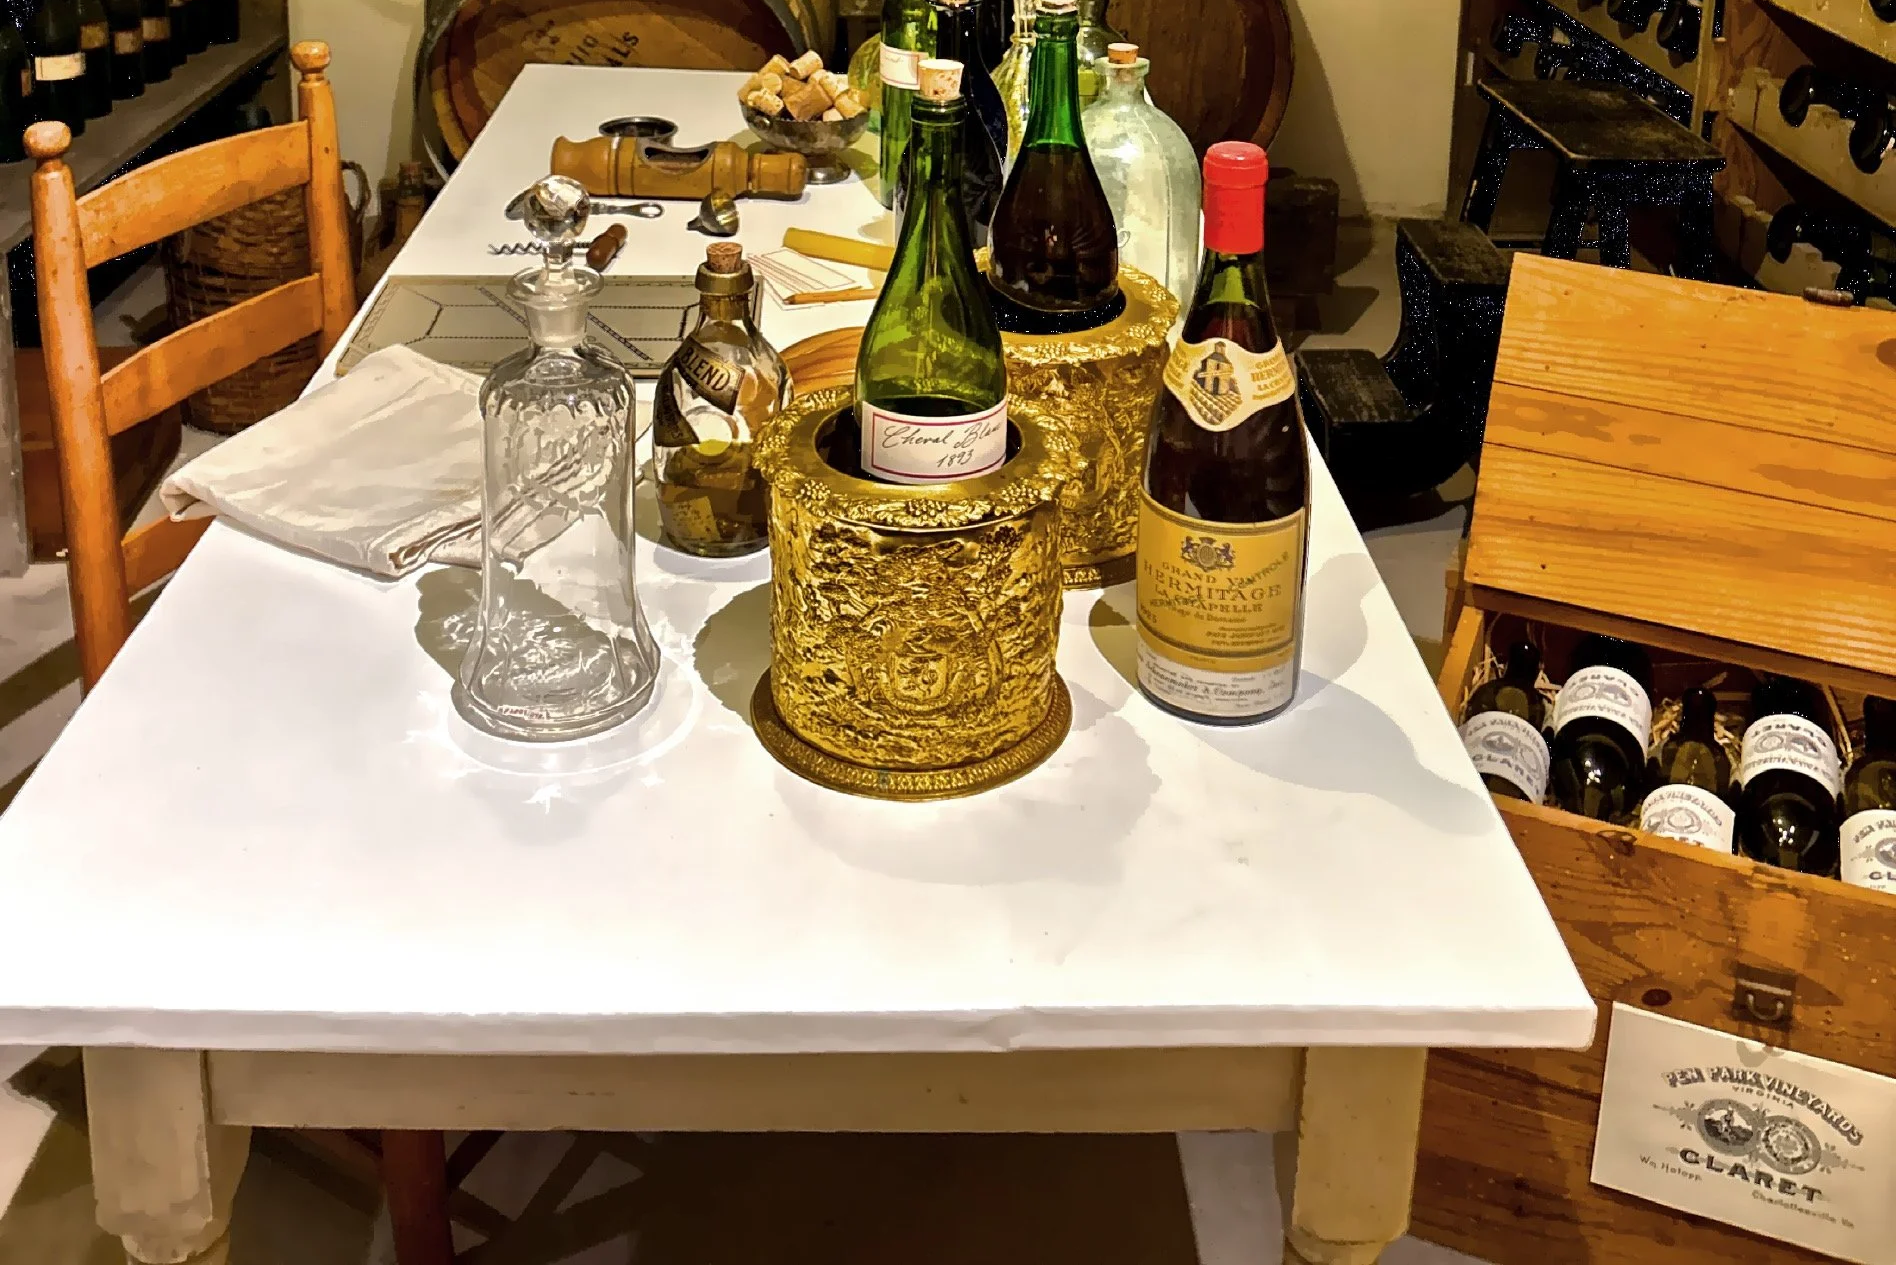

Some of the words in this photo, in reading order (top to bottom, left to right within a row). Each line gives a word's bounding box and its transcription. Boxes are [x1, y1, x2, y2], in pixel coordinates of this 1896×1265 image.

[682, 346, 732, 391] BLEND
[936, 450, 974, 468] 1893
[1143, 558, 1282, 602] HERMITAGE
[1162, 562, 1217, 584] GRAND
[1661, 1067, 1706, 1088] PEN
[1708, 1066, 1762, 1087] PARK
[1760, 1074, 1864, 1146] VINEYARDS
[1679, 1147, 1822, 1204] CLARET
